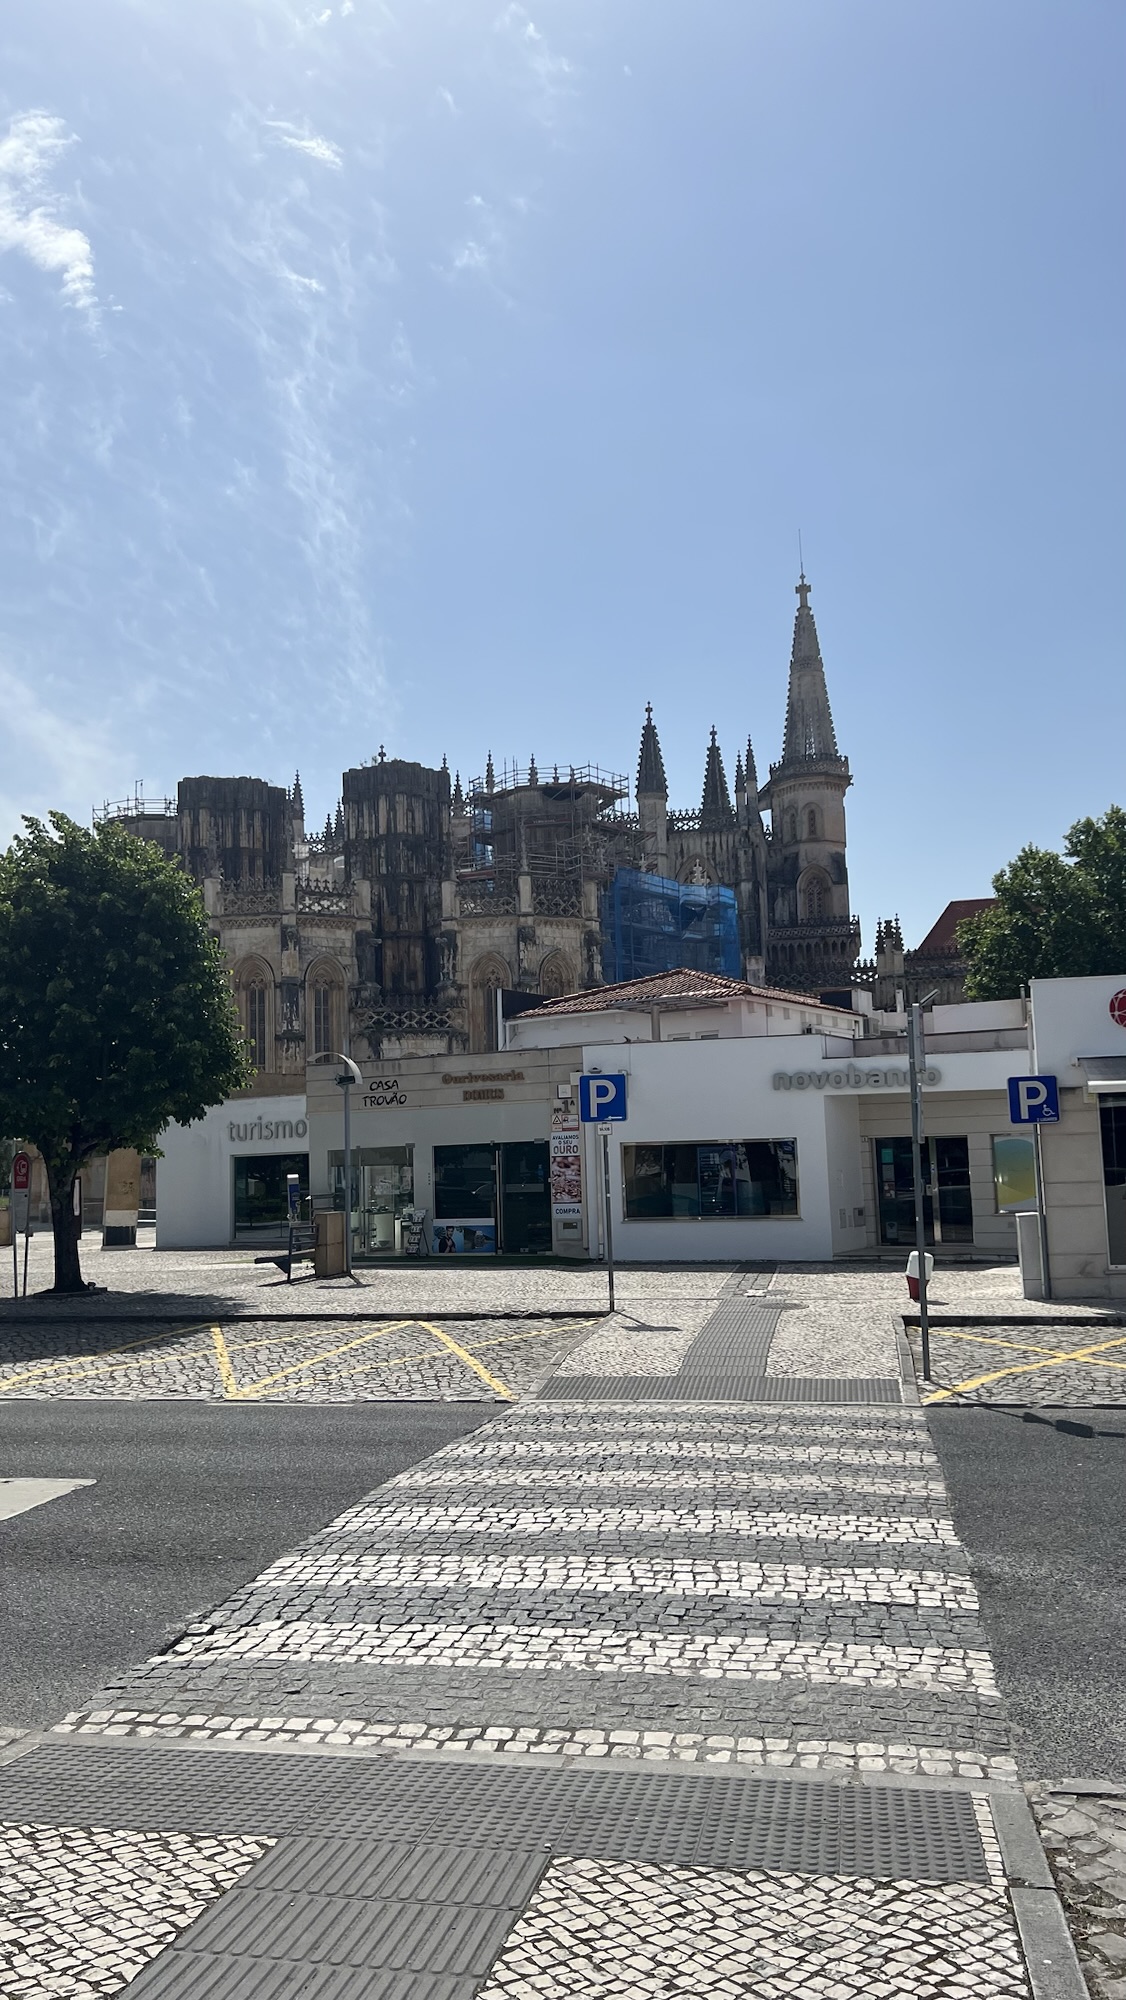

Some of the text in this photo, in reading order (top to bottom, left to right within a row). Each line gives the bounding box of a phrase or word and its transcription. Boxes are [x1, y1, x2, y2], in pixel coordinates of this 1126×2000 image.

[369, 1079, 399, 1092] CASA
[442, 1070, 525, 1085] Ourivesaria
[772, 1063, 942, 1090] novobano
[362, 1092, 407, 1107] TROVÃO
[589, 1079, 616, 1118] P
[1018, 1081, 1047, 1119] P
[226, 1115, 307, 1142] turismo
[553, 1145, 578, 1155] OURO
